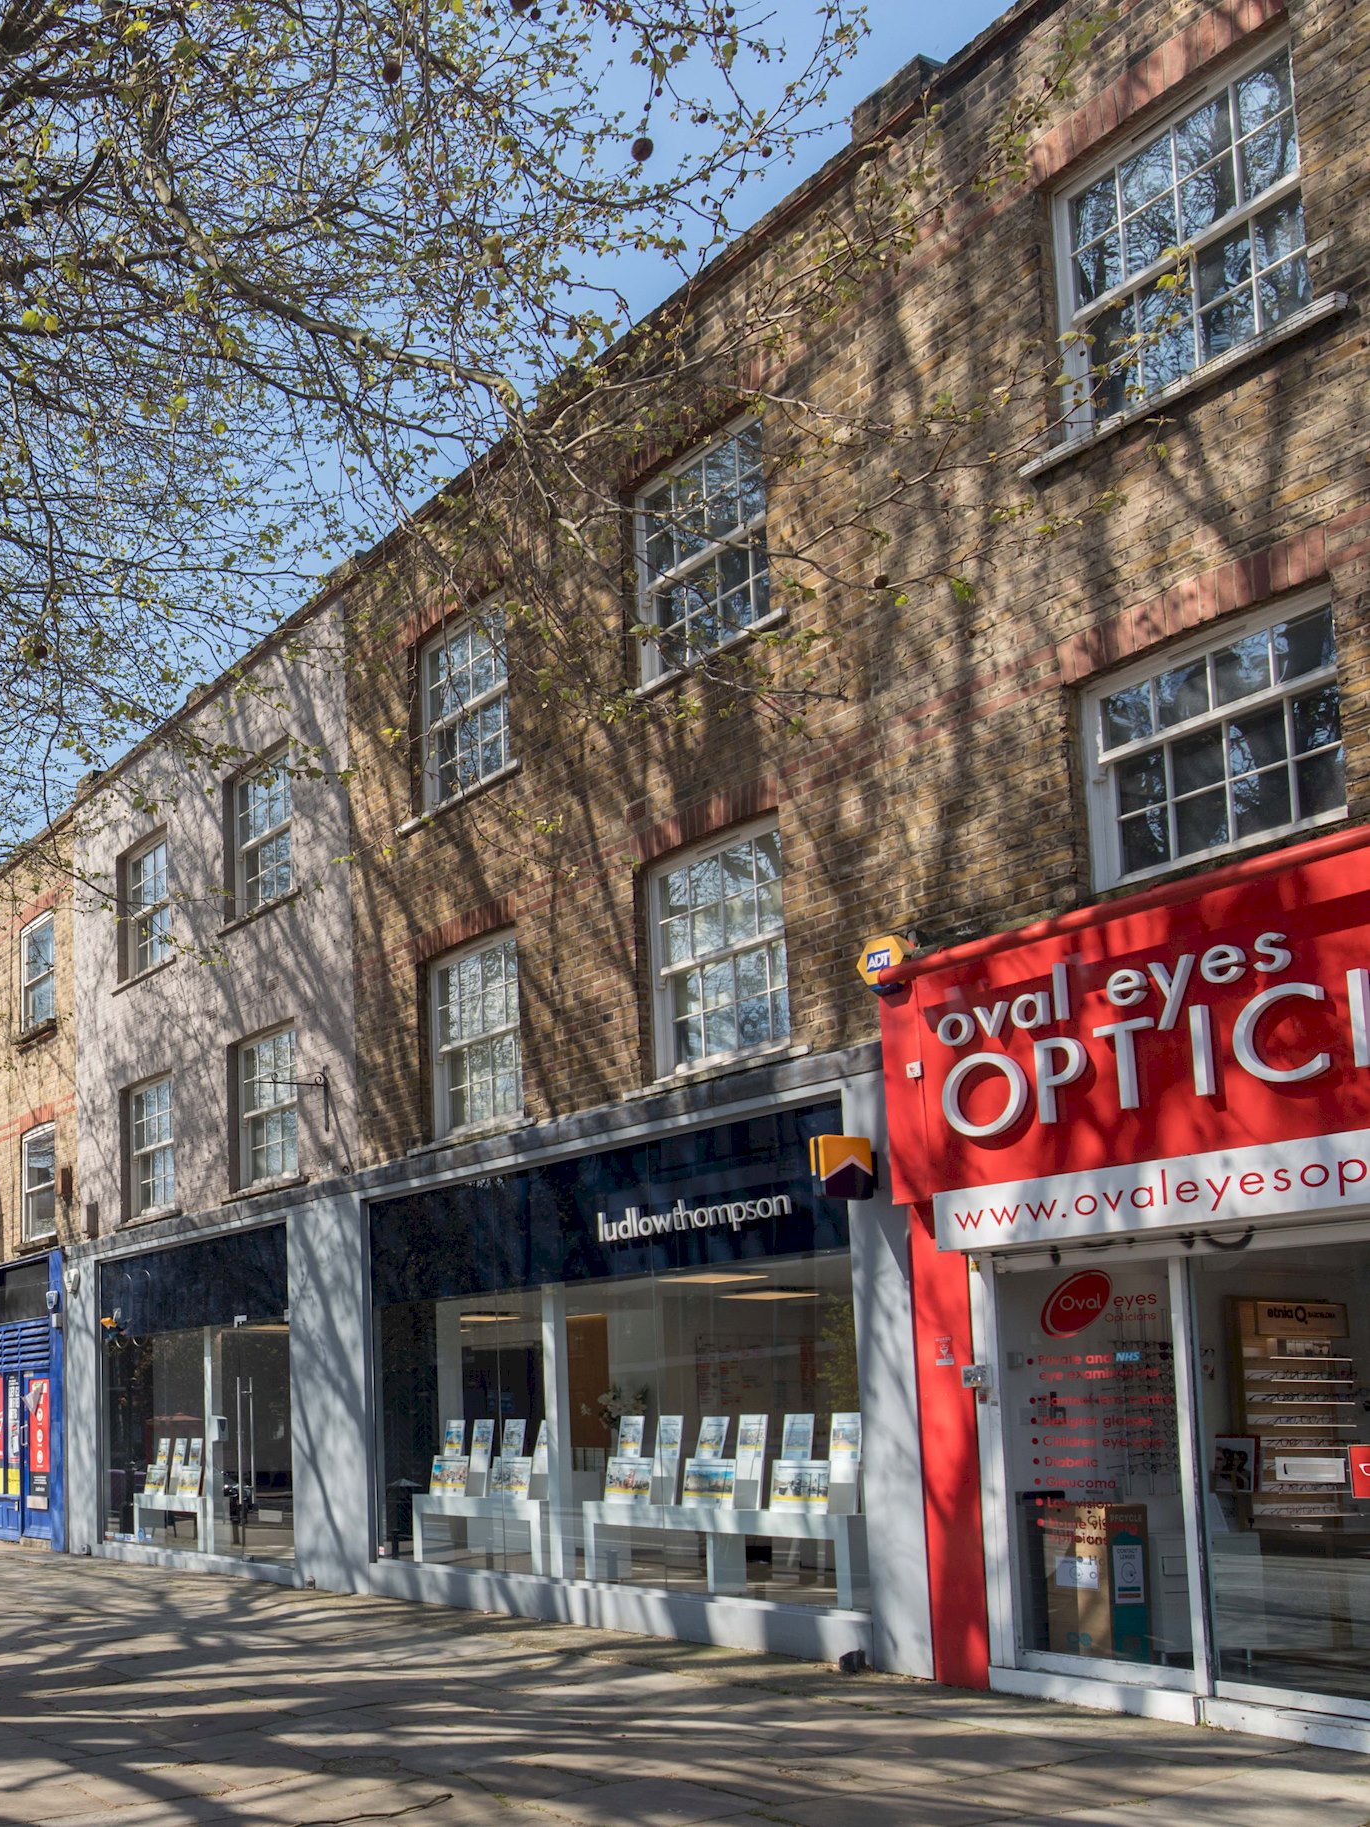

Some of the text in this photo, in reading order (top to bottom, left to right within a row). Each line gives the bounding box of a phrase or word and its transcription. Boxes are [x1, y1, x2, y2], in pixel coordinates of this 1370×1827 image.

[867, 951, 890, 969] ADT
[936, 931, 1293, 1047] oval eyes
[954, 1157, 1369, 1232] www.ovaleyesop
[596, 1193, 793, 1244] ludlowthompson
[1059, 1293, 1157, 1311] Oval eyes
[1105, 1311, 1157, 1325] Opticians
[1267, 1305, 1294, 1319] etnia
[1038, 1352, 1140, 1366] Private and NHS
[1039, 1367, 1159, 1383] eye examinations
[1042, 1415, 1153, 1430] Designer glasses
[1043, 1435, 1097, 1448] Children
[1102, 1438, 1127, 1449] eye
[1045, 1456, 1099, 1468] Diabetic
[1046, 1476, 1117, 1489] Glaucoma
[1078, 1498, 1114, 1510] vision
